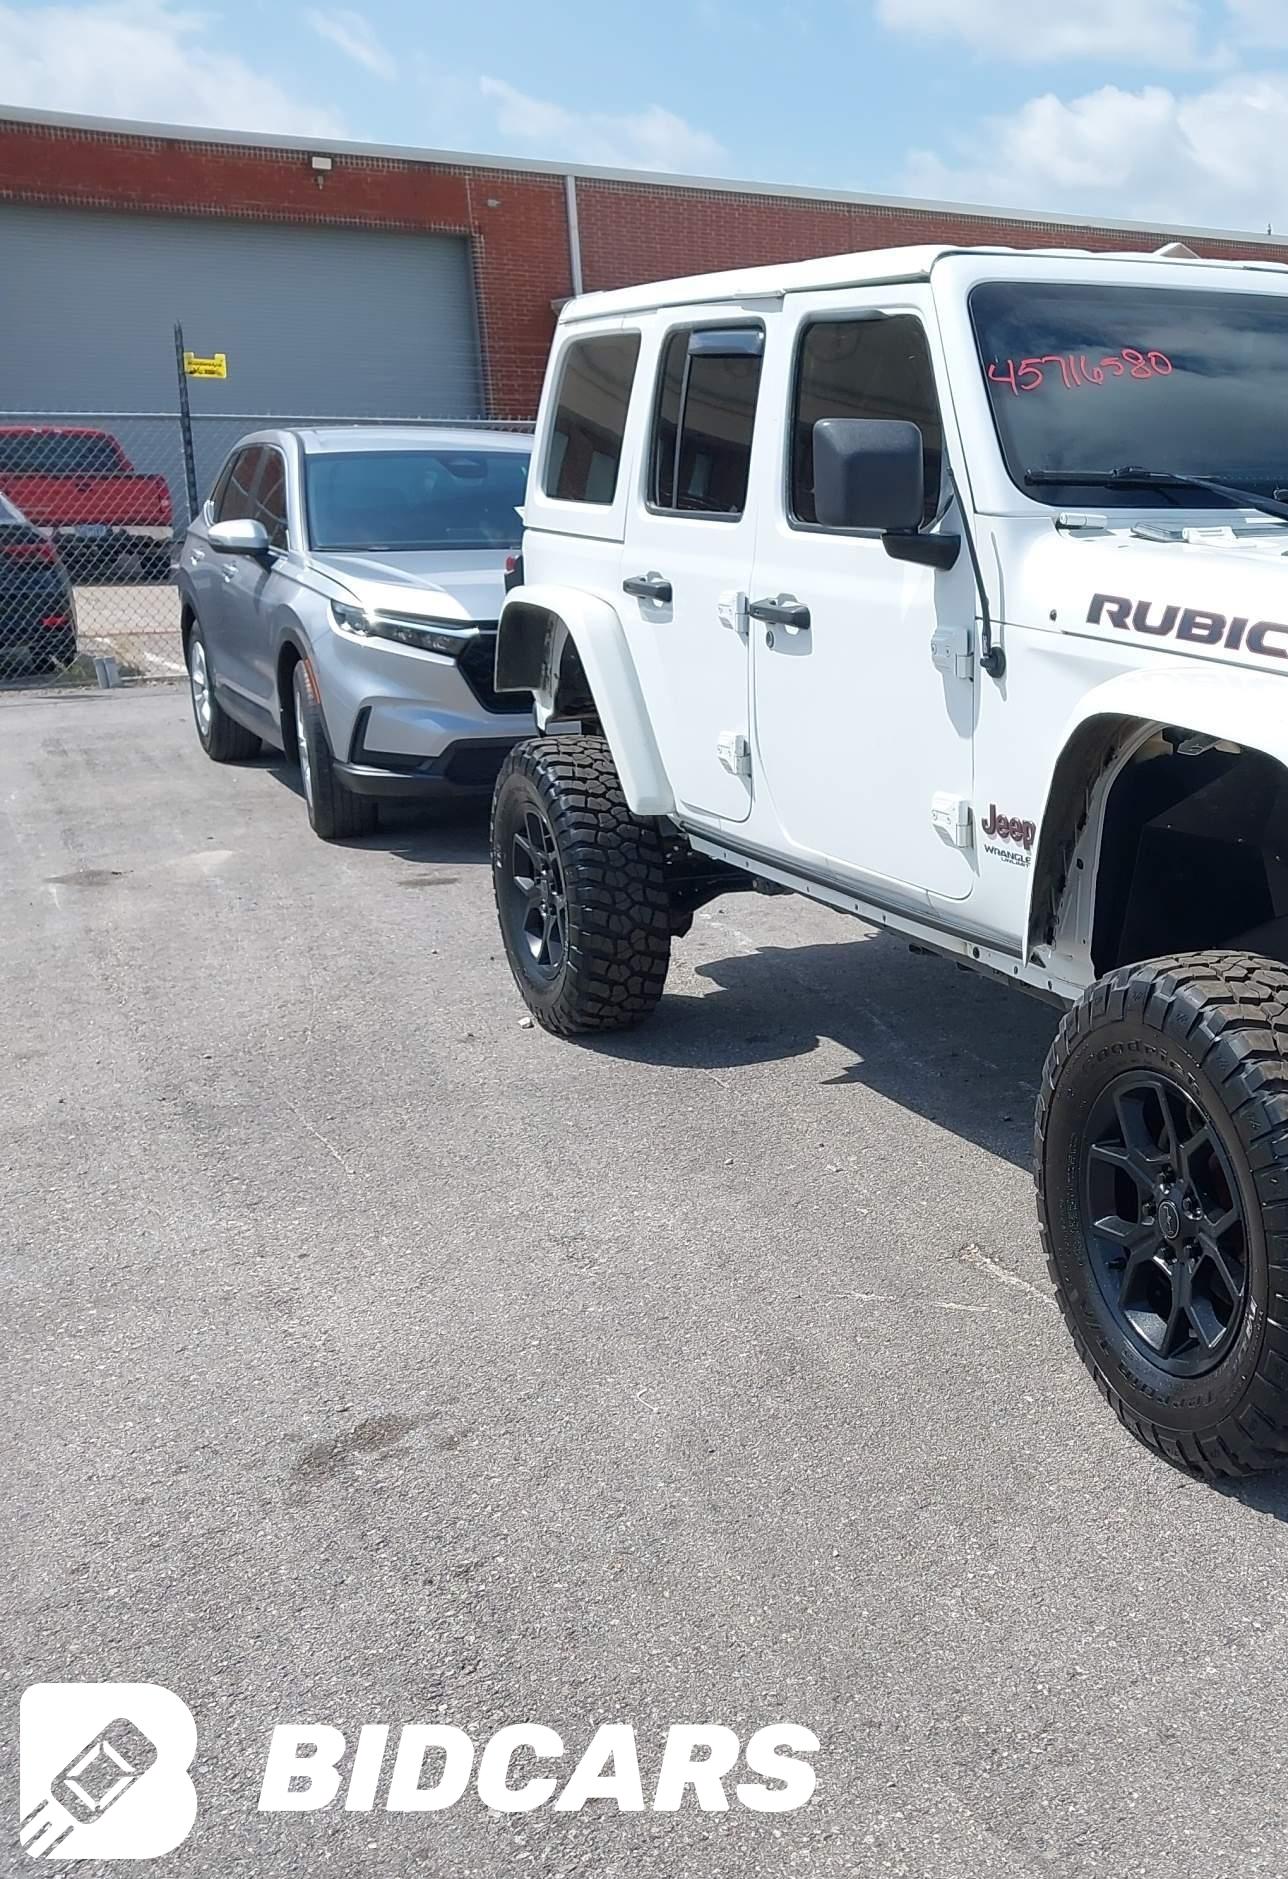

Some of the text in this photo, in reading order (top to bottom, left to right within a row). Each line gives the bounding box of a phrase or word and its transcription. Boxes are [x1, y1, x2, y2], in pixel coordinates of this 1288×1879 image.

[988, 348, 1173, 396] 45716580
[981, 803, 1036, 851] Jeep
[984, 844, 1032, 864] WRANGLE
[1001, 856, 1030, 868] UNLIMIT
